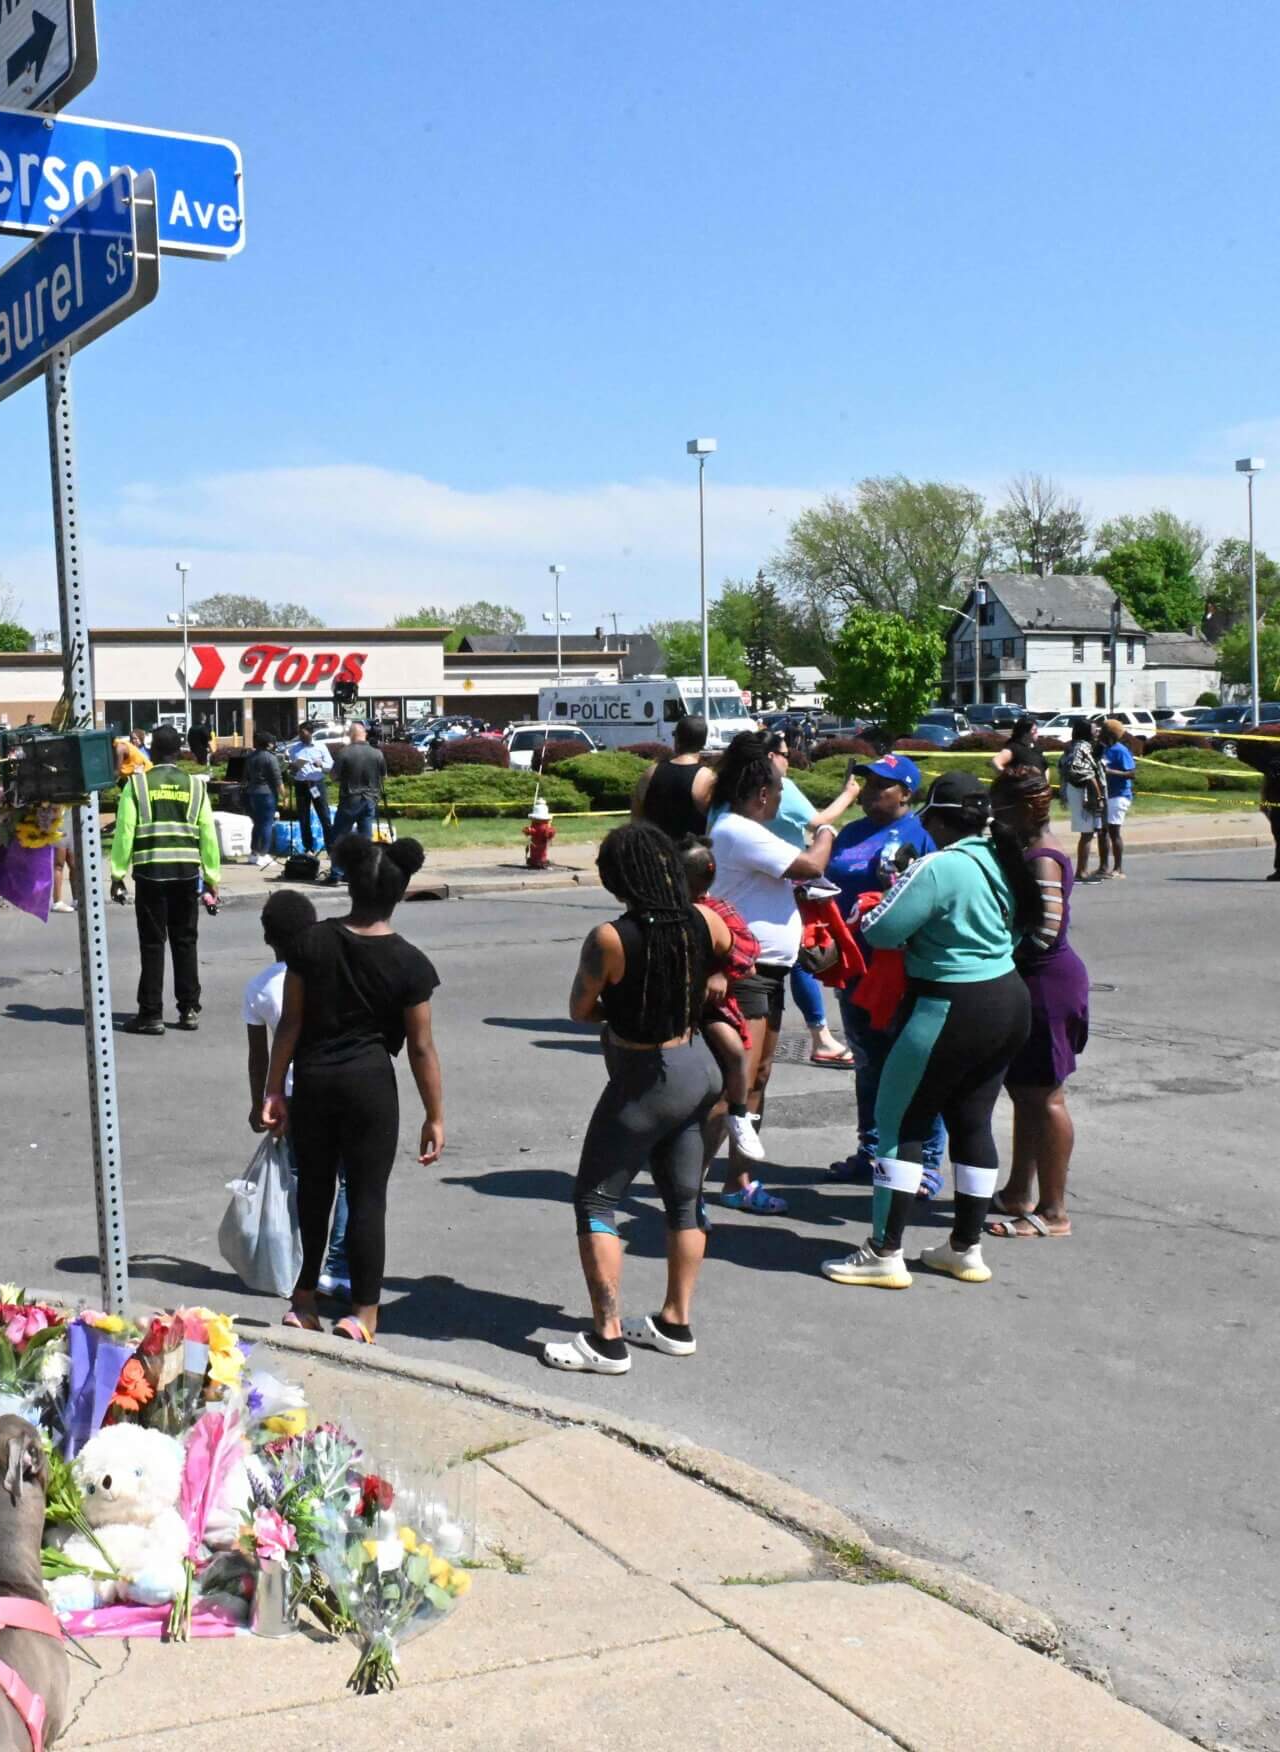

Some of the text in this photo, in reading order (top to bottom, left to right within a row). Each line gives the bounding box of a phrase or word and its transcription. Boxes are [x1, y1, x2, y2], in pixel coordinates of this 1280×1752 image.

[170, 190, 238, 232] Ave
[105, 240, 126, 285] St
[570, 703, 632, 720] POLICE
